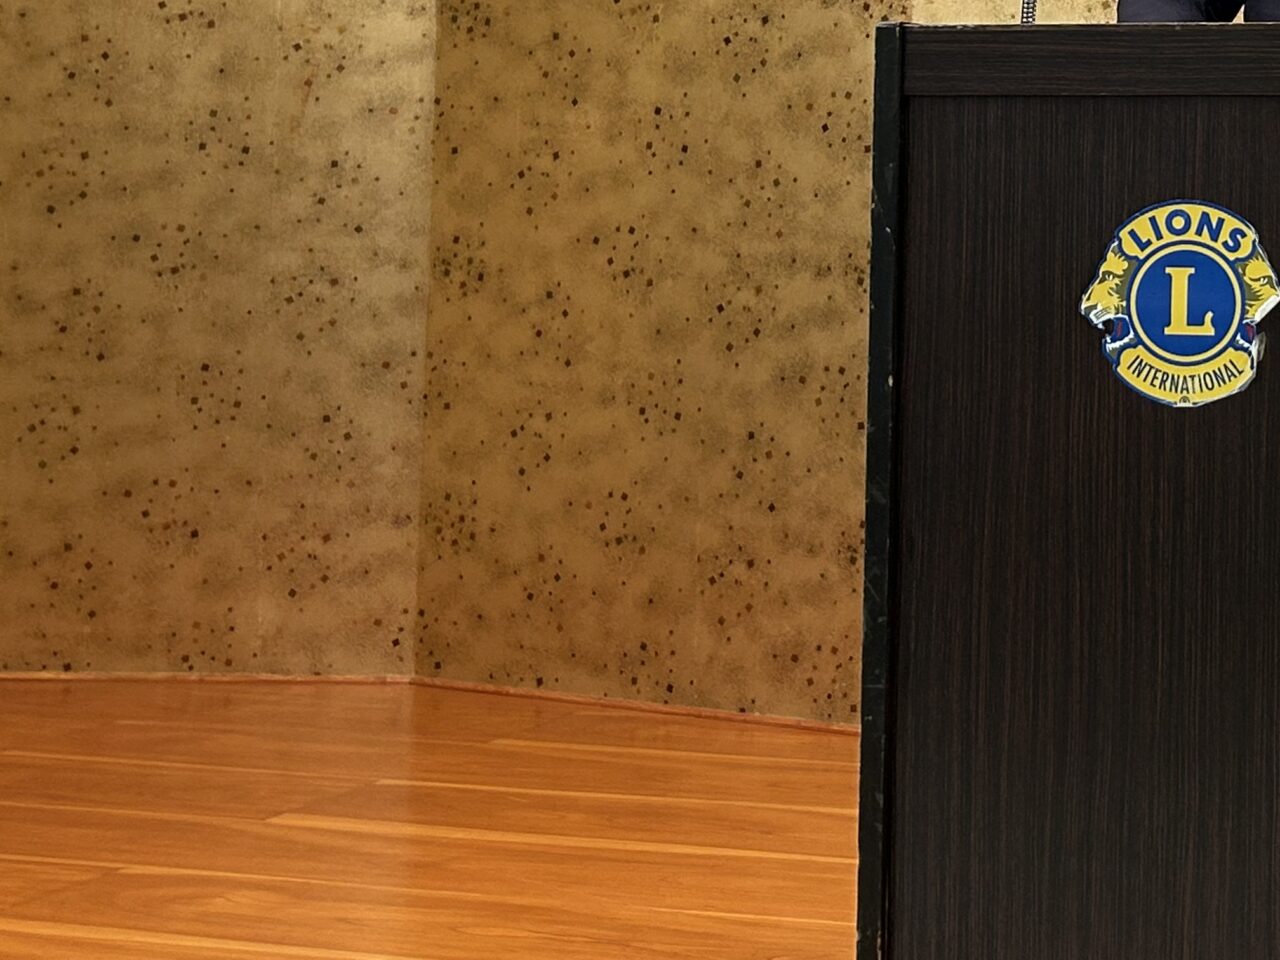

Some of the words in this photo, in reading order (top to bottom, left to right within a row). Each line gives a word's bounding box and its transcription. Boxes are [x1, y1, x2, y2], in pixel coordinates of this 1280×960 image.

[1126, 208, 1248, 253] LIONS
[1163, 266, 1216, 336] L
[1126, 354, 1245, 395] INTERNATIONAL
